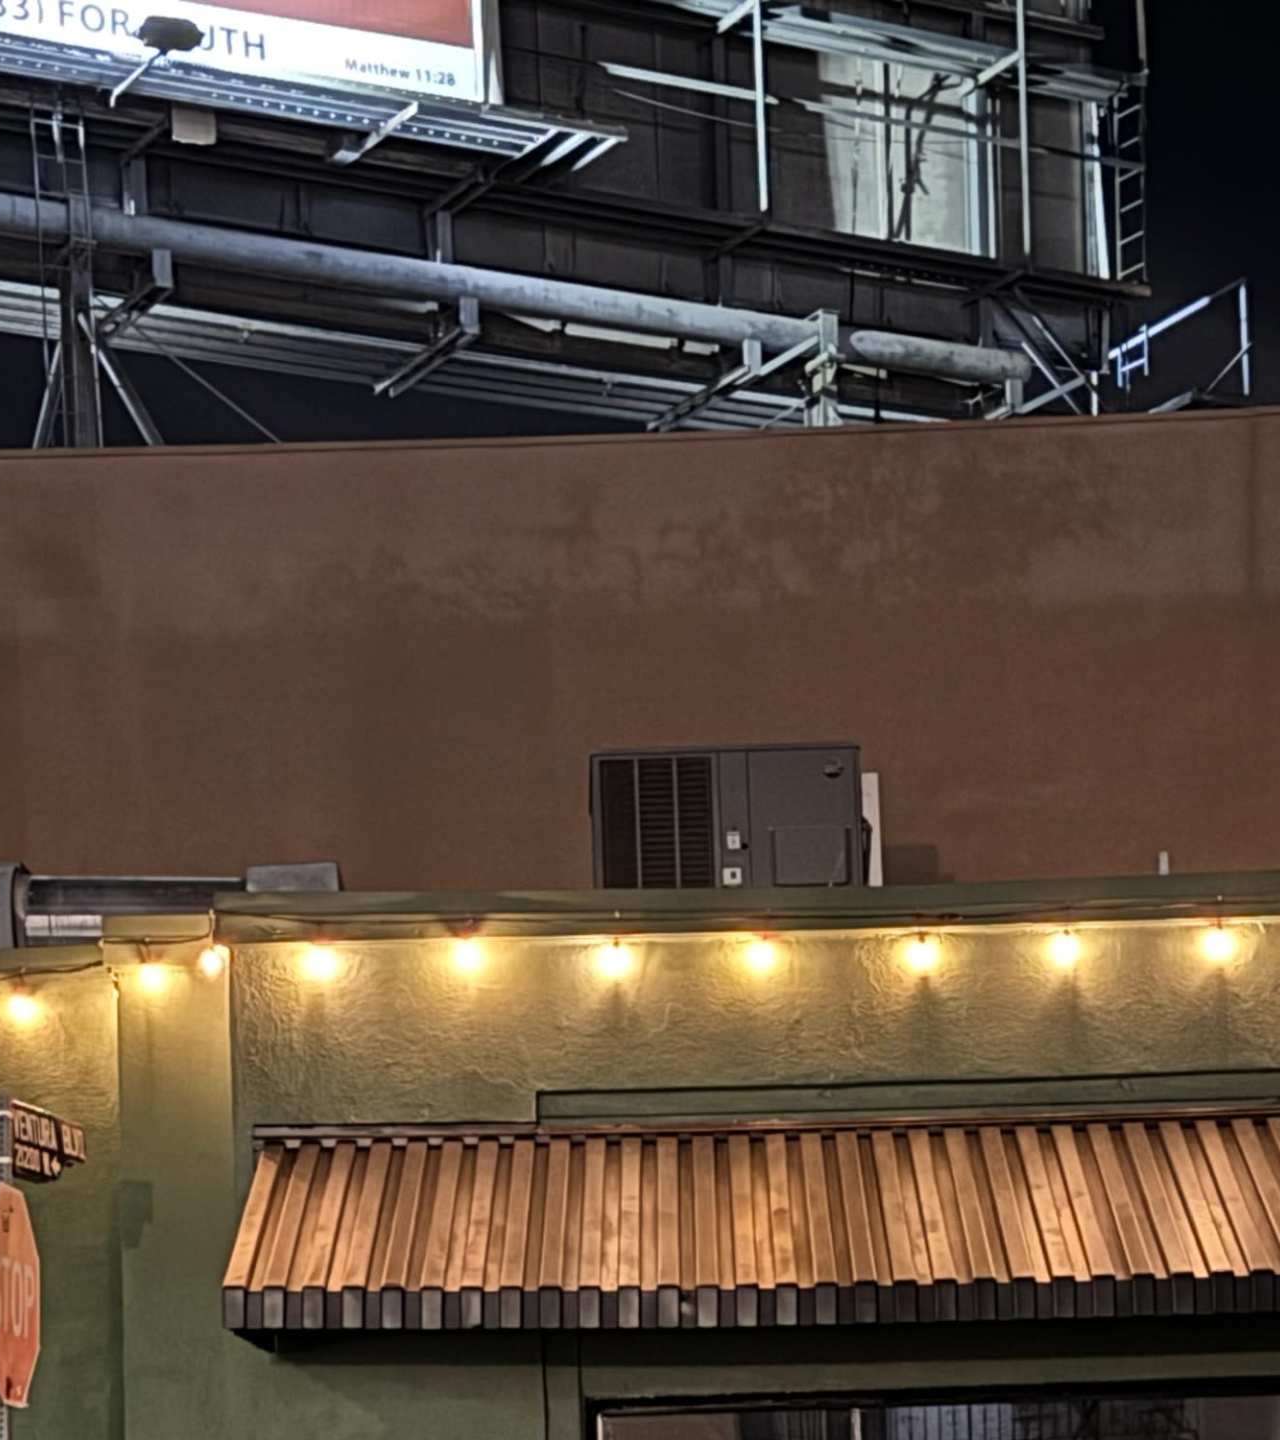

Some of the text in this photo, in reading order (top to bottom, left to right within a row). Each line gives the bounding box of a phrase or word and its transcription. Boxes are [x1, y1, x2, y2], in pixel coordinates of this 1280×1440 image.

[58, 1, 134, 37] FOR
[344, 58, 457, 87] Matthew 11:28
[13, 1109, 58, 1151] VENTURA
